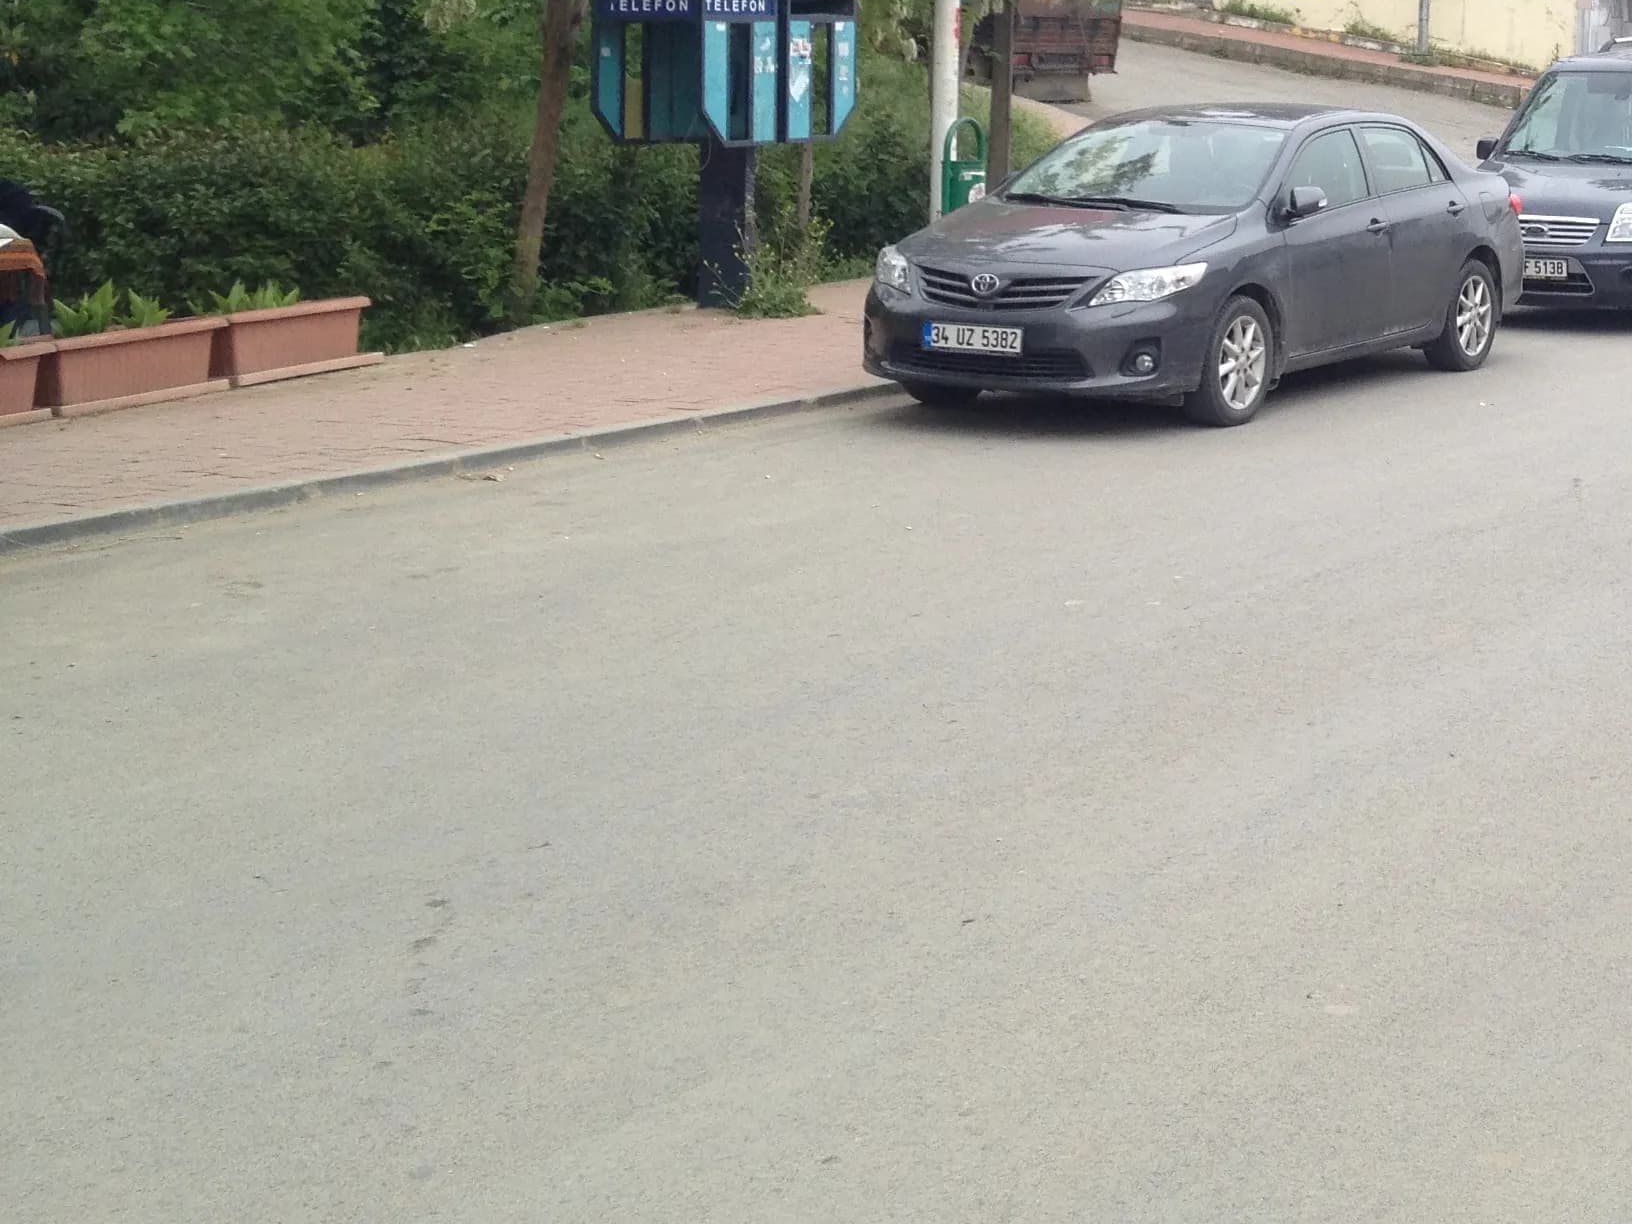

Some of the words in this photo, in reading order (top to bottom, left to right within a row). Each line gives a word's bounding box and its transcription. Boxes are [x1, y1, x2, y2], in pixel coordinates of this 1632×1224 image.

[1534, 261, 1564, 275] 5138
[932, 326, 949, 345] 34
[956, 327, 975, 346] UZ
[981, 329, 1018, 349] 5382
